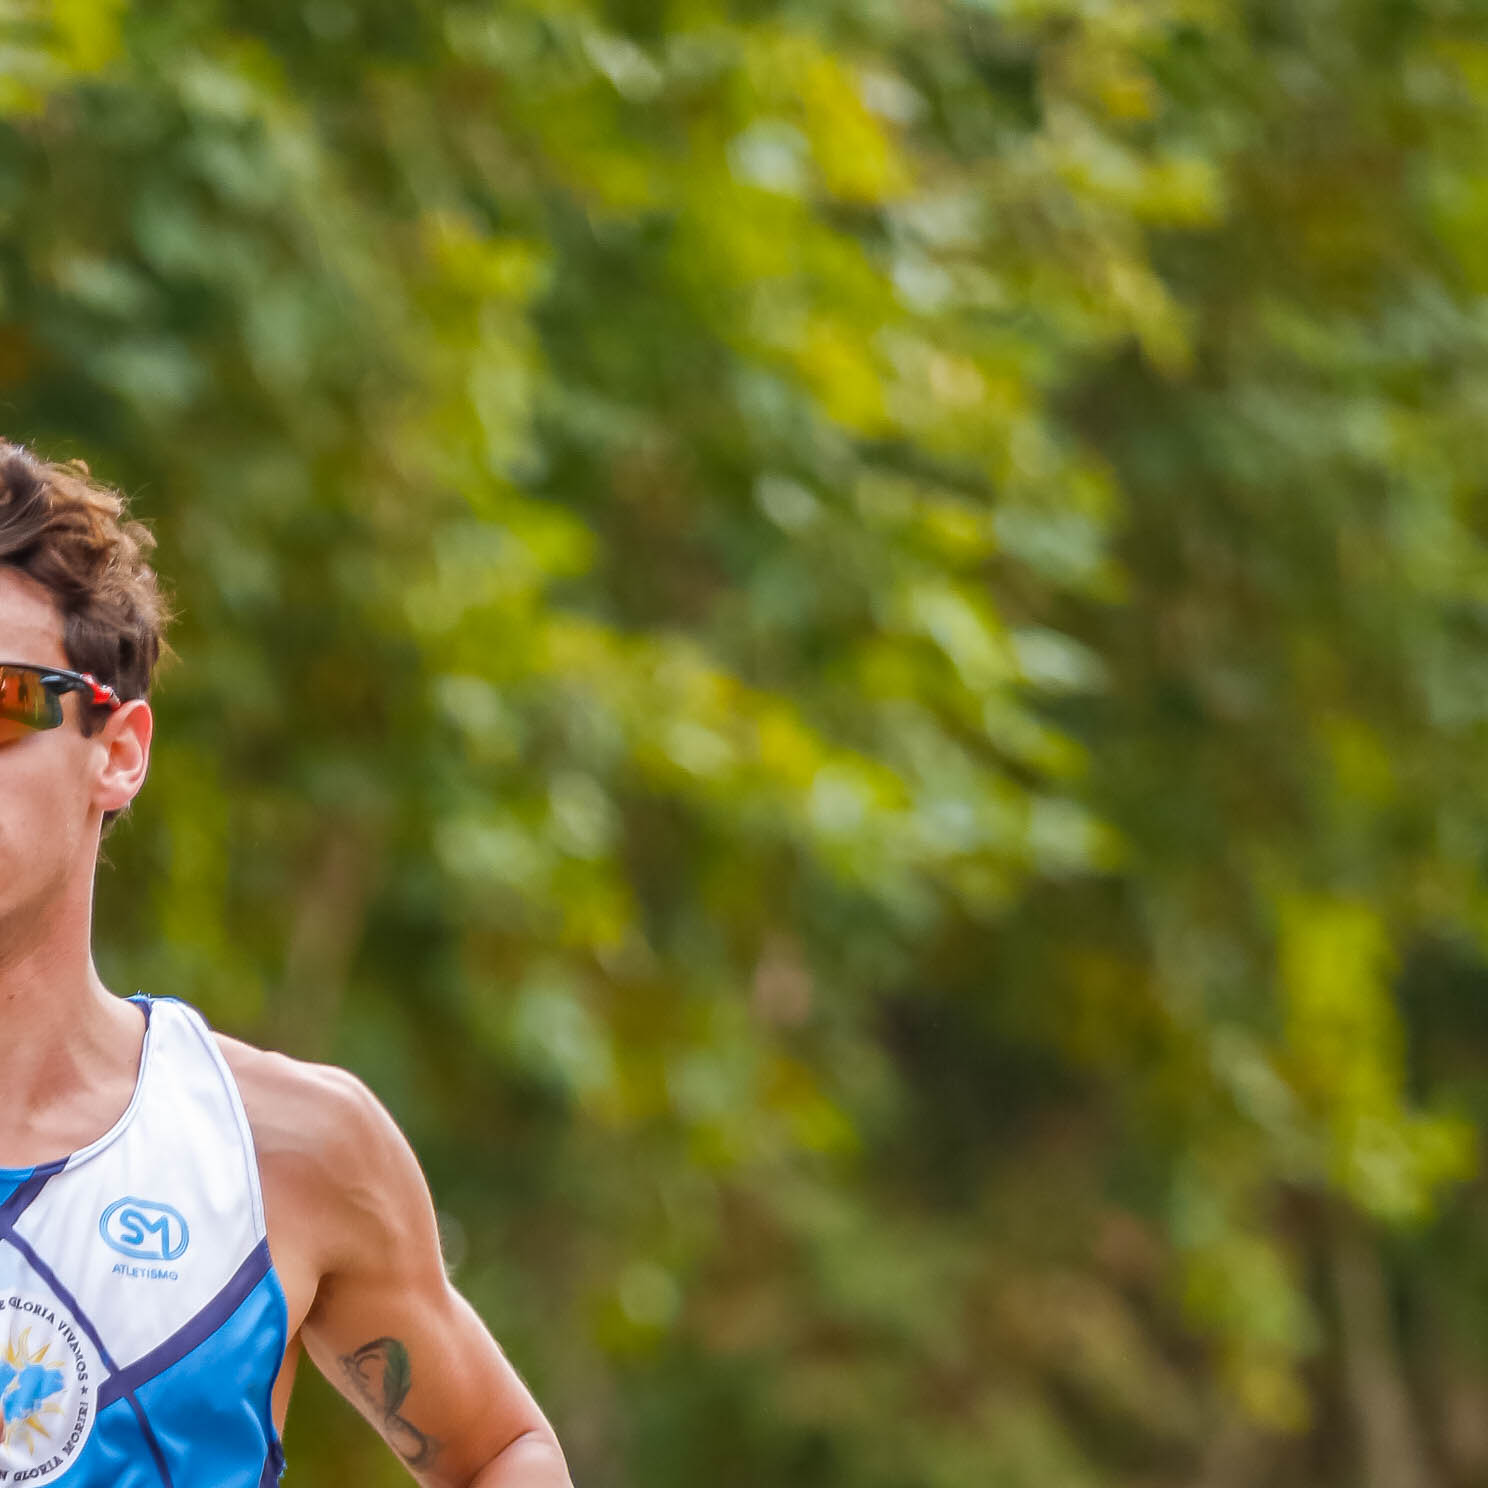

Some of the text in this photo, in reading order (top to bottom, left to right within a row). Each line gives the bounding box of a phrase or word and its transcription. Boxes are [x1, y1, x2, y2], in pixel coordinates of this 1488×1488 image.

[119, 1209, 170, 1260] SM
[112, 1263, 178, 1281] ATLETISMO
[8, 1296, 55, 1325] GLORIA
[57, 1320, 89, 1382] VIVAMOS
[13, 1455, 64, 1481] GLORIA
